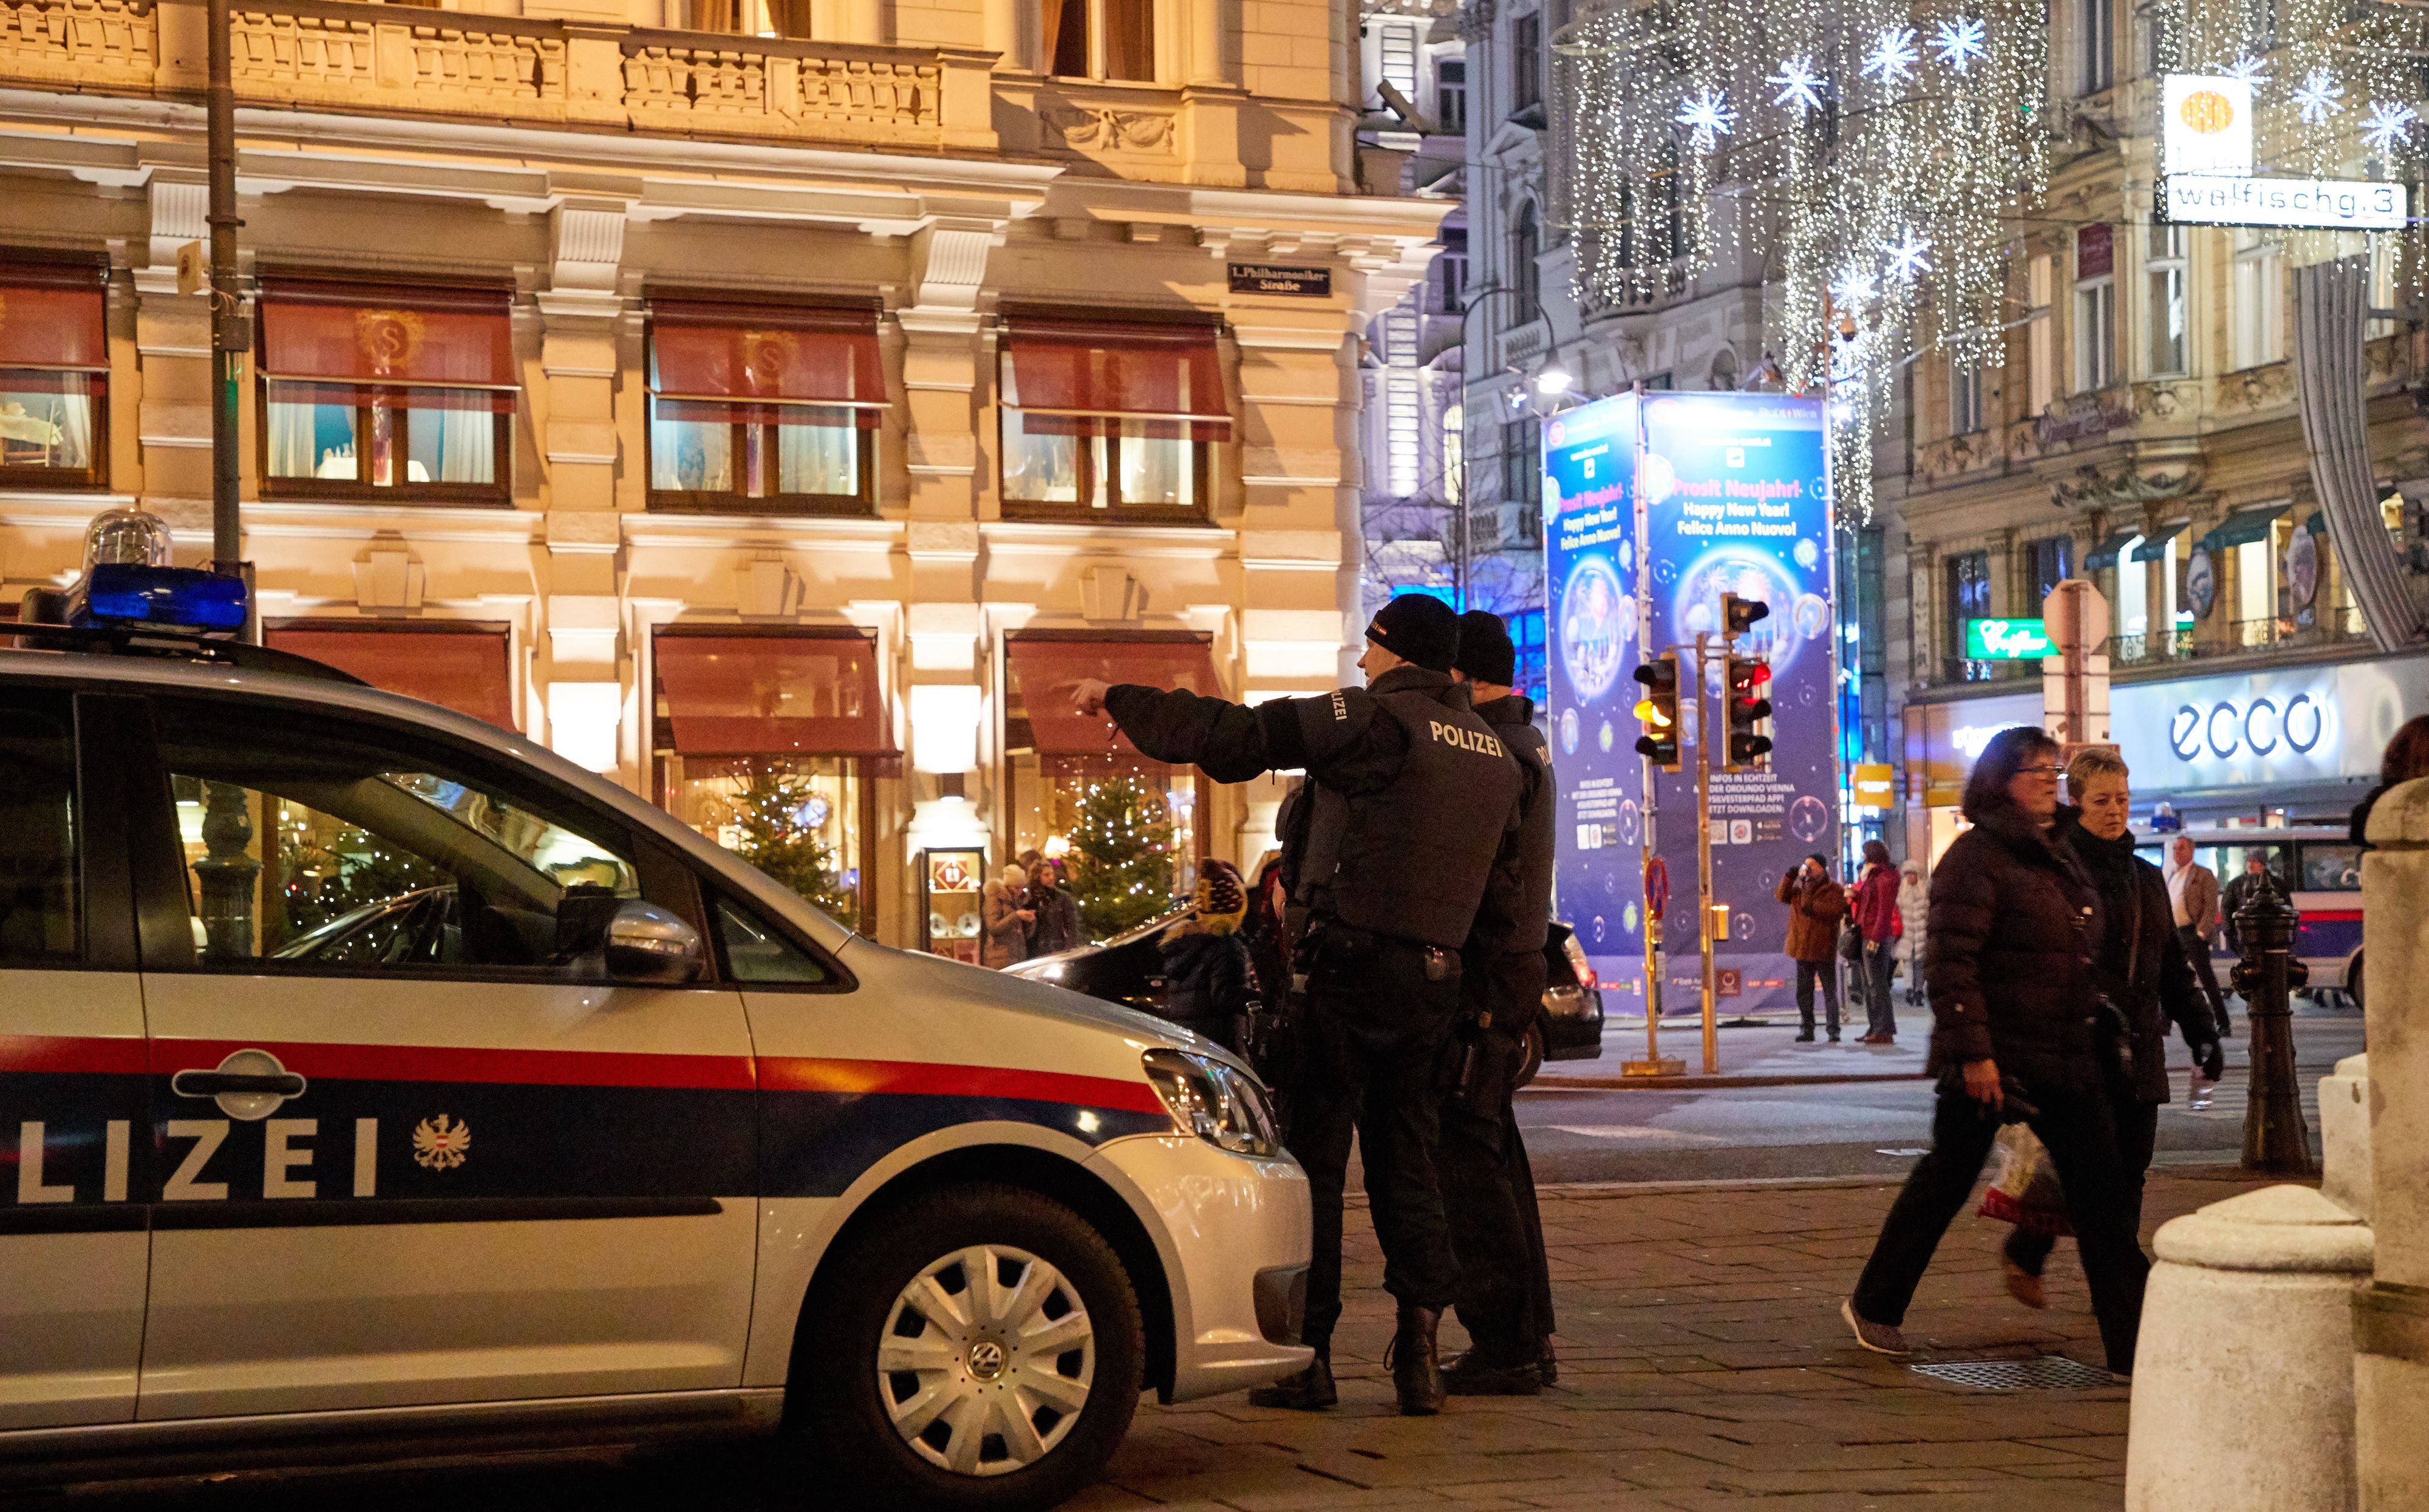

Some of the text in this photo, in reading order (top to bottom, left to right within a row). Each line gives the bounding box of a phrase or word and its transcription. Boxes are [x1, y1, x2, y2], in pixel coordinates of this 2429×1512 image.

[1259, 279, 1301, 291] Straße
[1672, 478, 1800, 503] Prosit Neujahr!
[1683, 502, 1790, 520] Happy New Year!
[1677, 520, 1796, 536] Felice Anno Nuovo!
[2170, 692, 2332, 764] ecco
[1429, 721, 1502, 758] POLIZEI
[1710, 773, 1778, 783] INFOS IN ECHTZEIT
[1766, 783, 1795, 793] VIENNA
